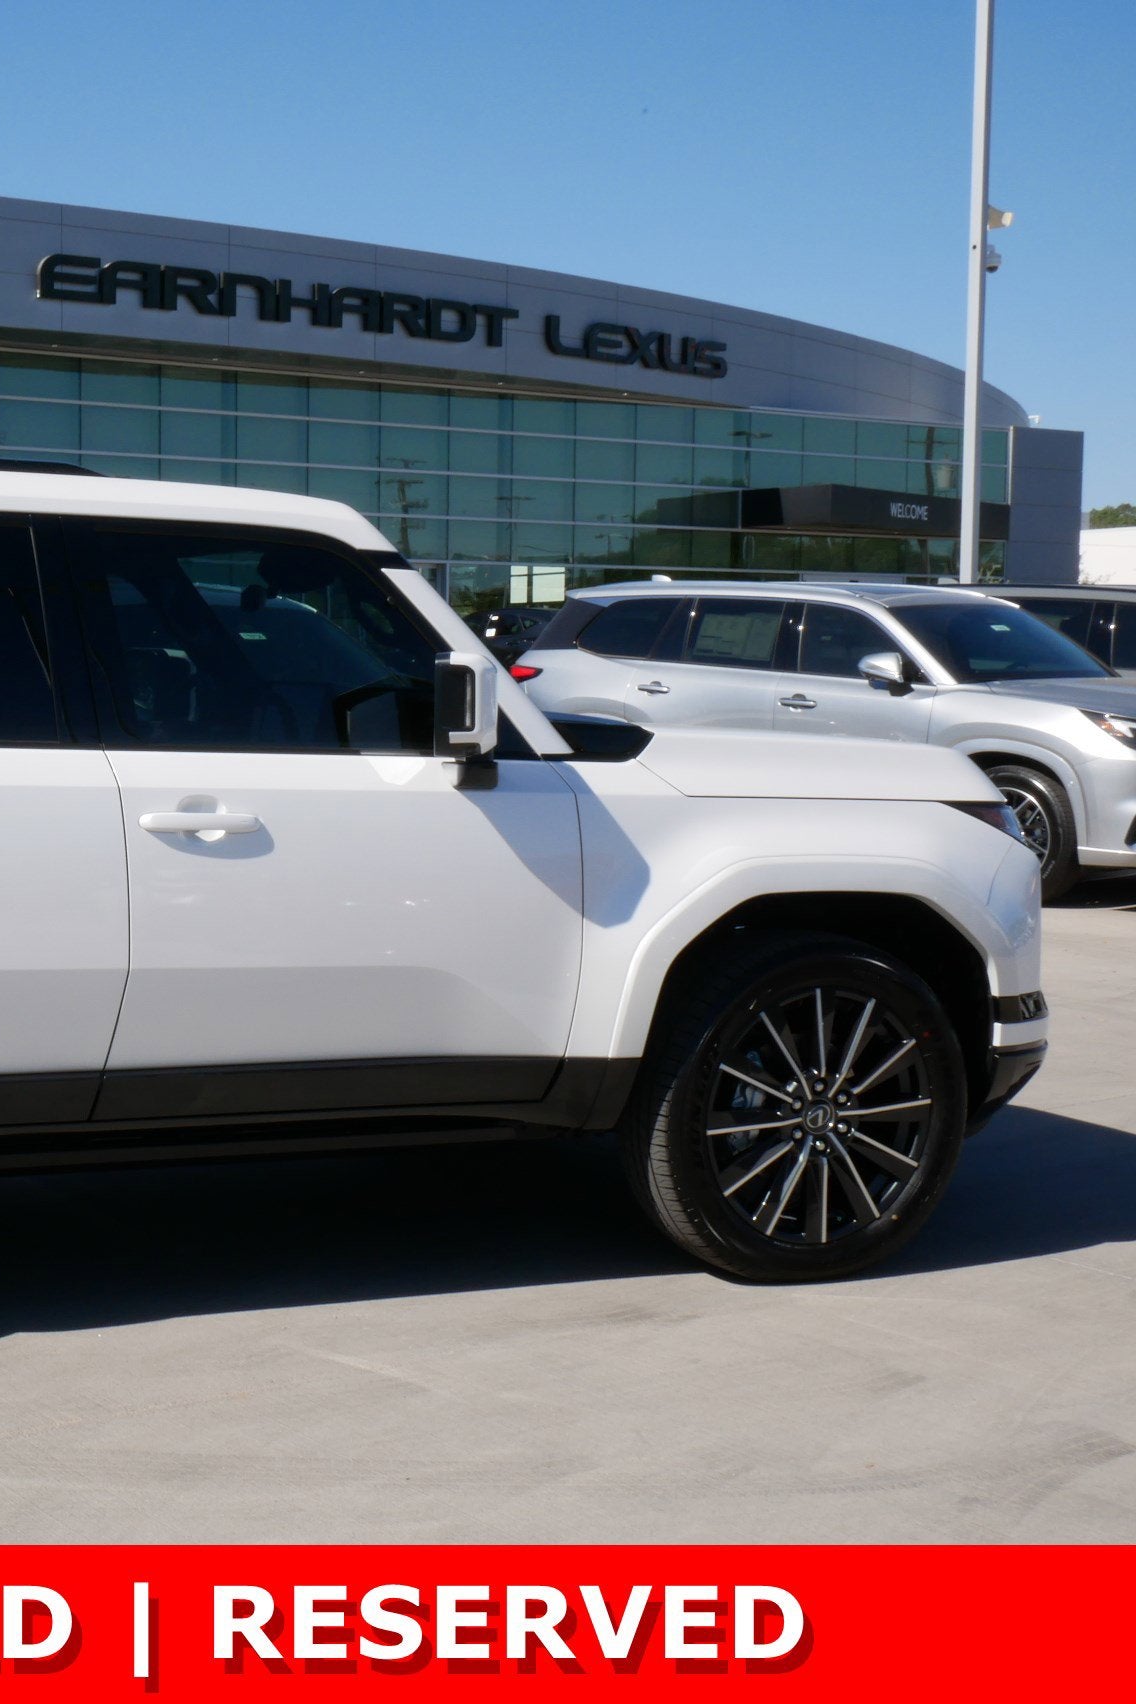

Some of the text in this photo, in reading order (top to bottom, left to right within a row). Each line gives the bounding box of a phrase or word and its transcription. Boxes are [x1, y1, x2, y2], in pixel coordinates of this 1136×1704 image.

[36, 253, 729, 380] EARNHARDT LEXUS
[890, 502, 929, 521] WELCOME
